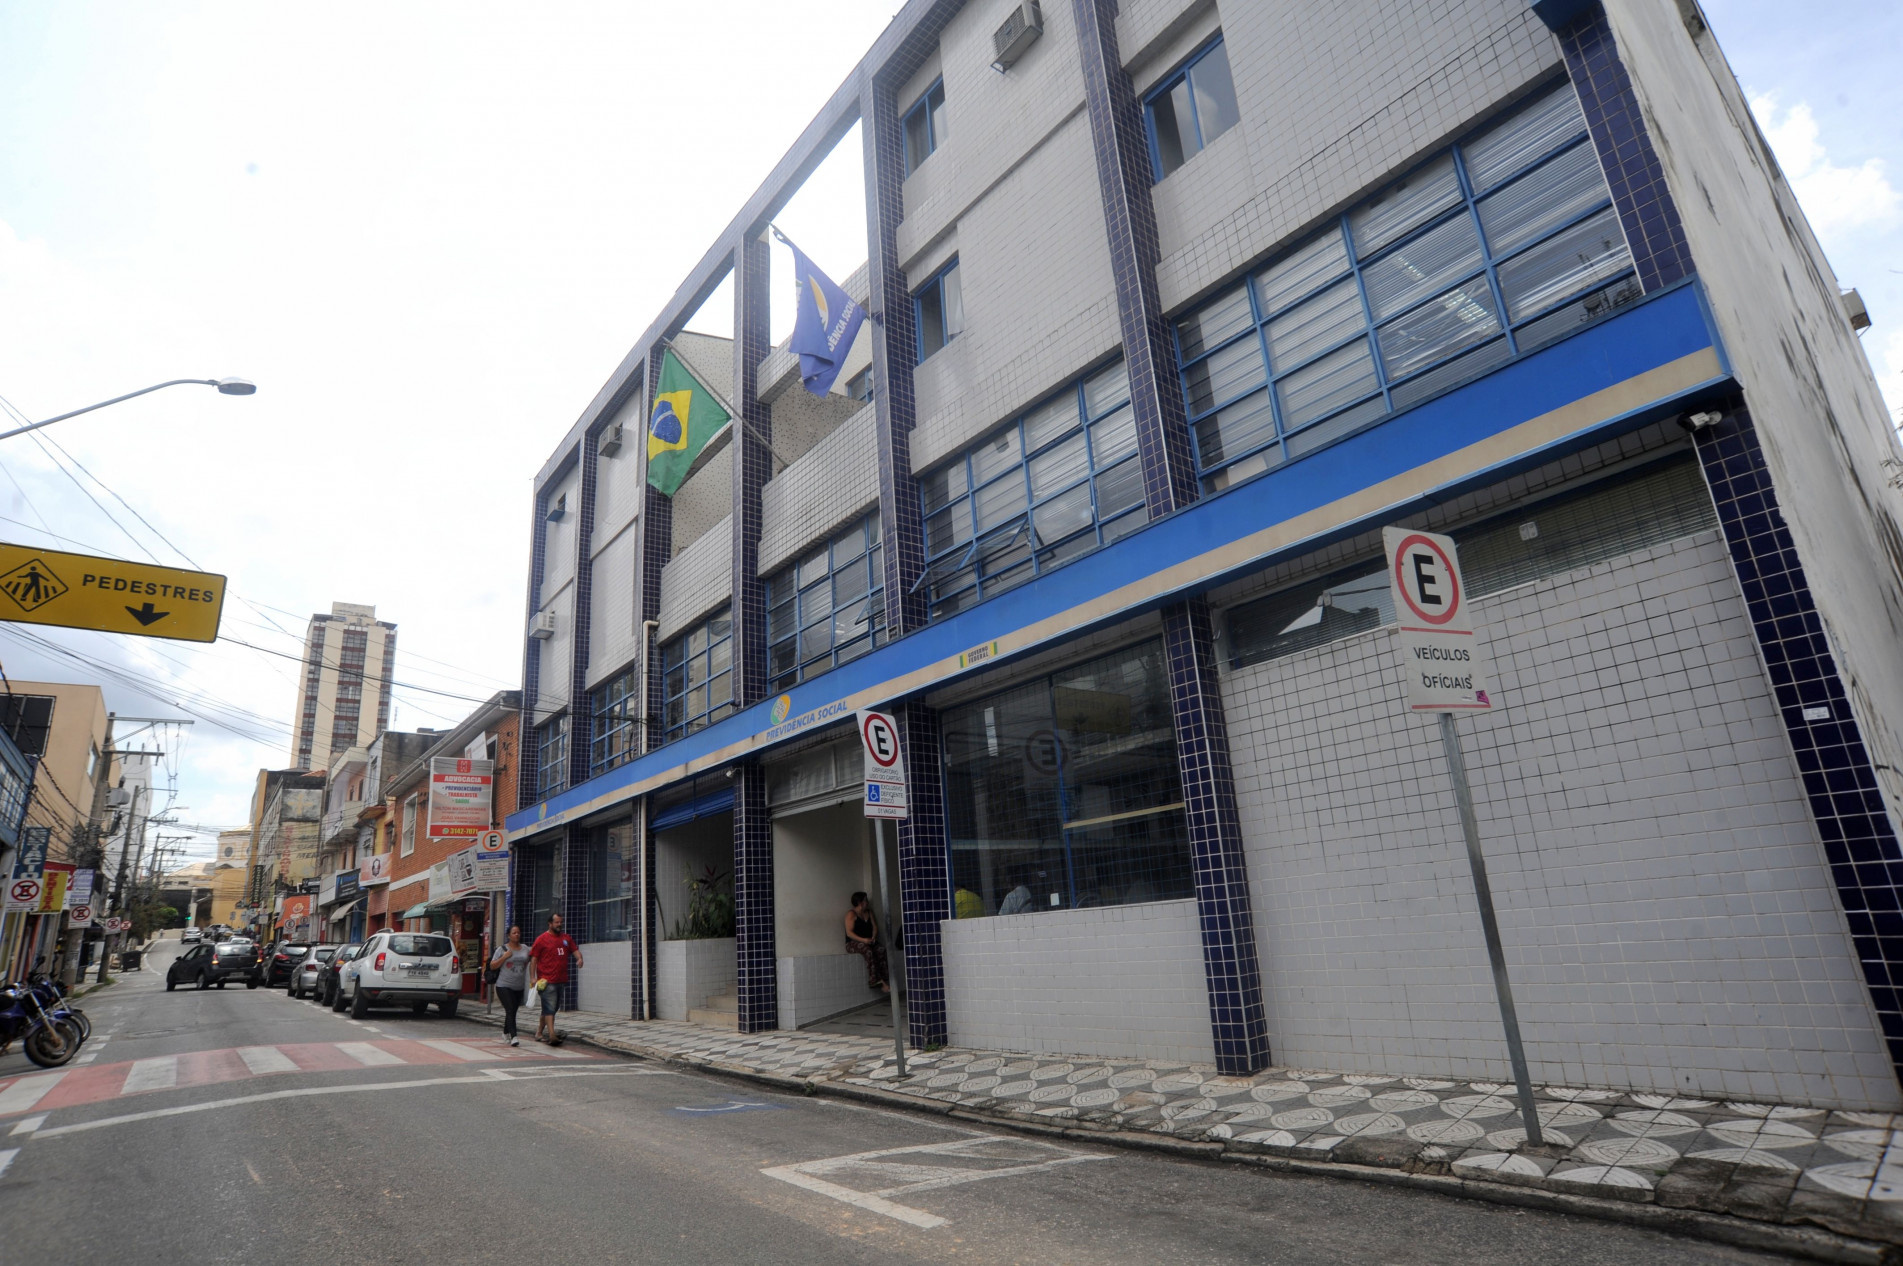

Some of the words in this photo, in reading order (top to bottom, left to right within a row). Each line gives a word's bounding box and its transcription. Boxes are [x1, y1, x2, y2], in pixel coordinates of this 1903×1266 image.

[1413, 553, 1442, 605] E
[82, 574, 213, 603] PEDESTRES
[968, 645, 989, 657] GOVERNO
[968, 651, 989, 664] FEDERAL
[1413, 645, 1470, 661] VEÍCULOS
[766, 713, 815, 740] PREVIDÊNCIA
[818, 701, 847, 720] SOCIAL
[874, 725, 889, 755] E
[444, 775, 482, 783] ADVOCACIA
[880, 784, 903, 792] EXCLUSIVO
[490, 835, 498, 847] E
[557, 947, 564, 956] 13
